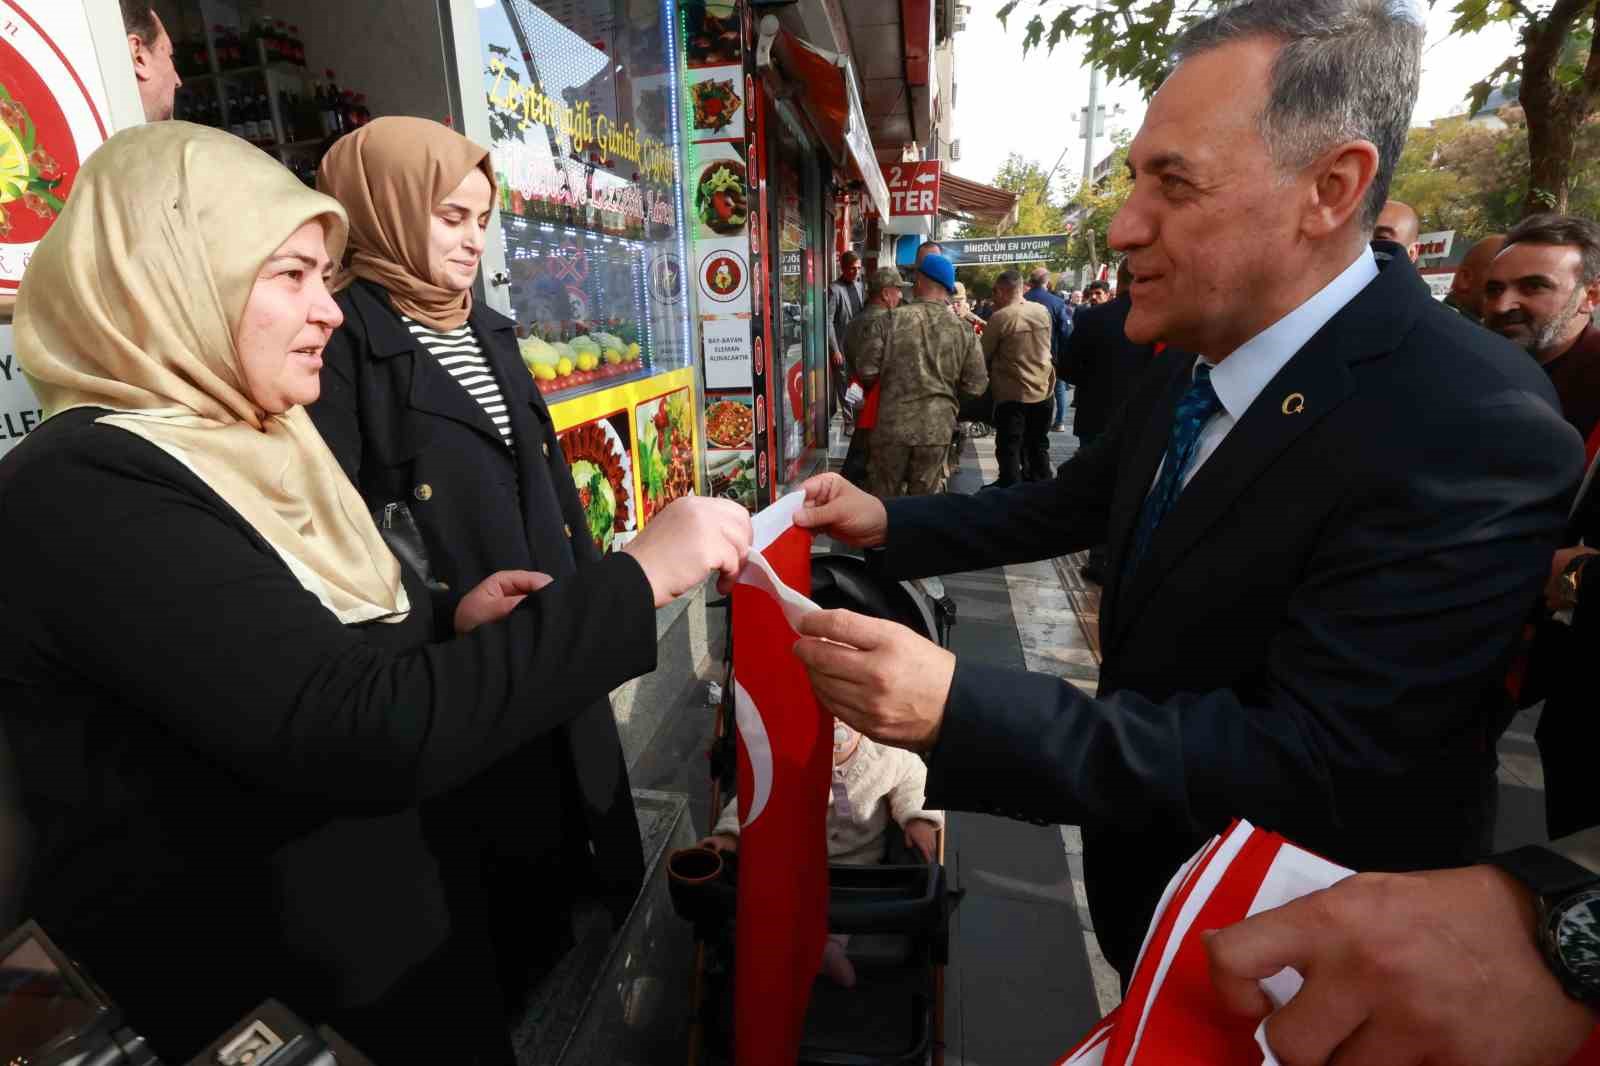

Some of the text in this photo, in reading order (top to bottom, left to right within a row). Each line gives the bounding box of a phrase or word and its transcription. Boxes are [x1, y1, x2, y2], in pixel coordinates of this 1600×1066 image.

[889, 166, 908, 188] 2.
[861, 190, 934, 214] NTER
[1008, 242, 1020, 251] EN
[1021, 240, 1050, 250] UYGUN
[978, 252, 1014, 262] TELEFON
